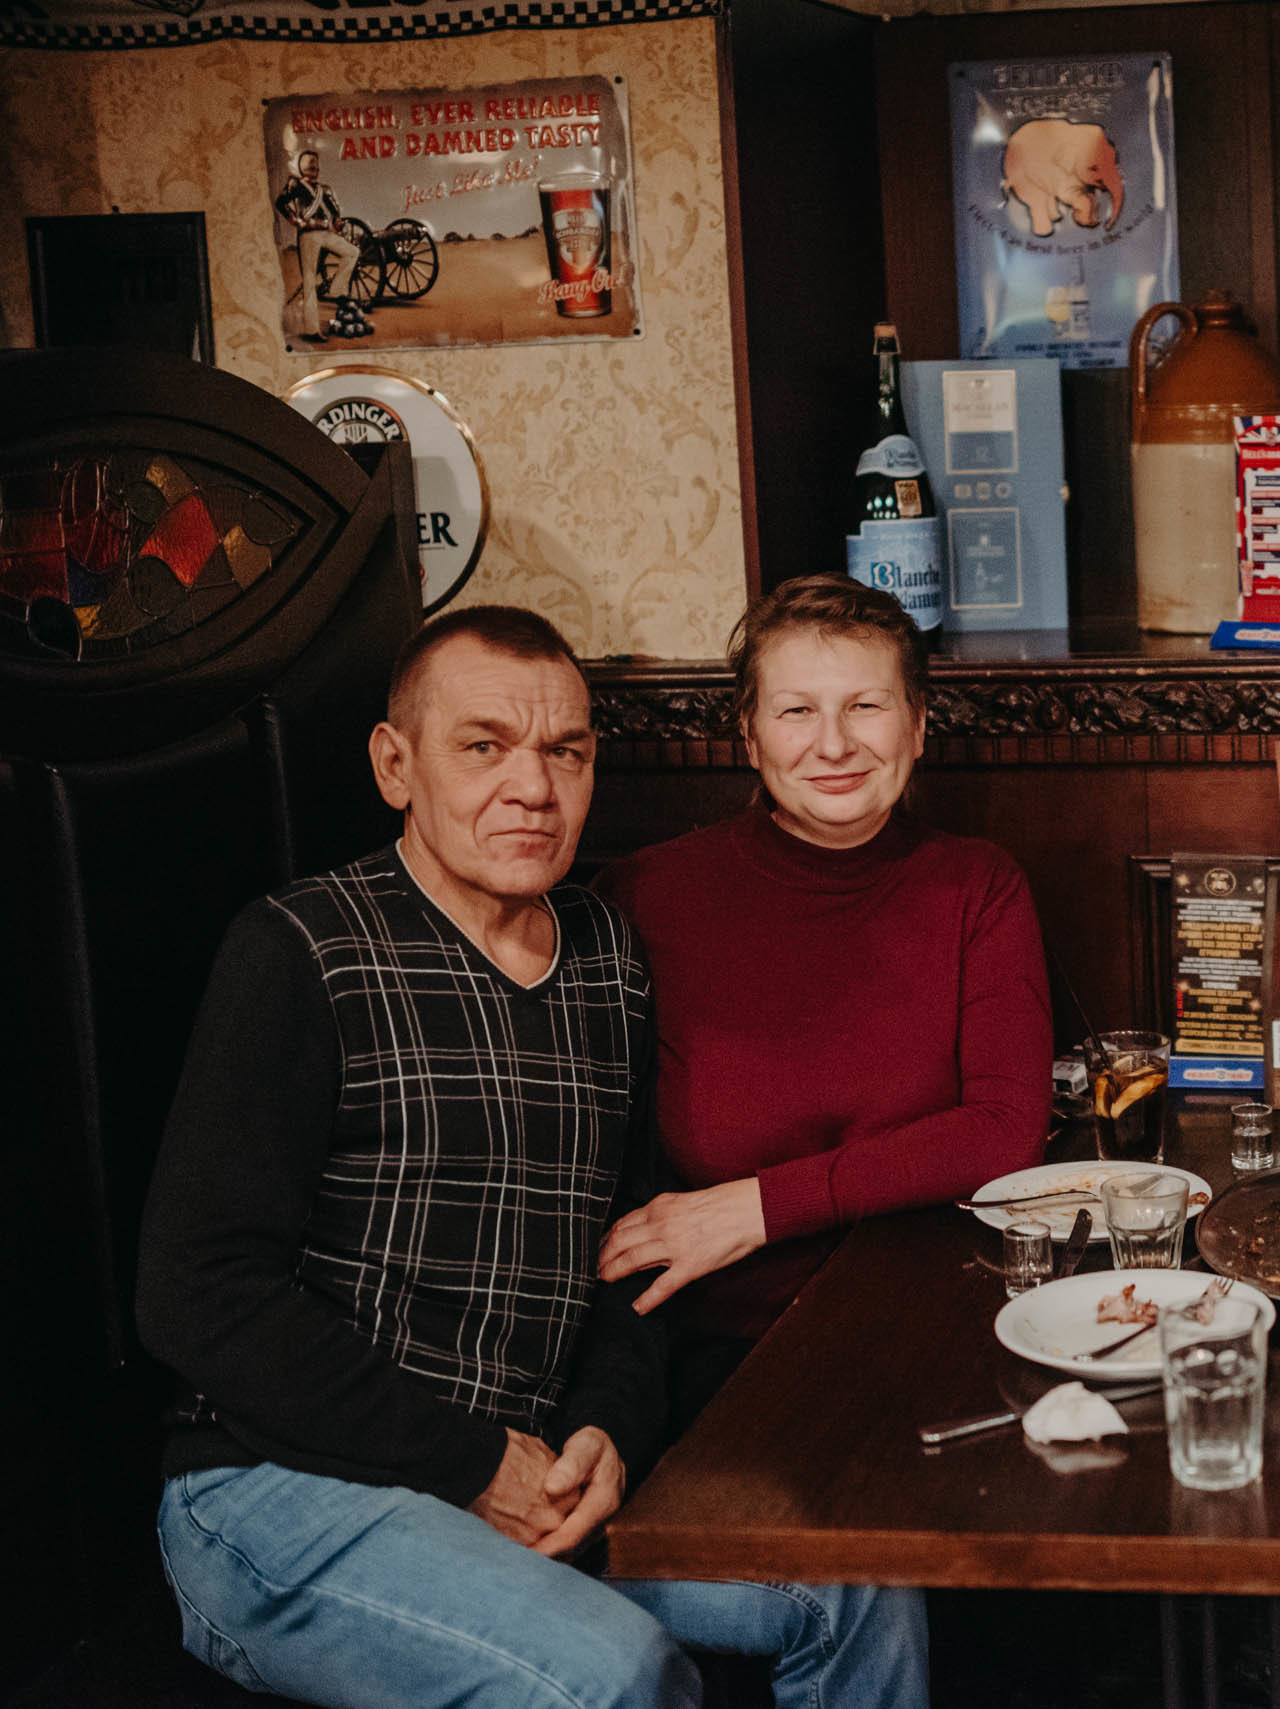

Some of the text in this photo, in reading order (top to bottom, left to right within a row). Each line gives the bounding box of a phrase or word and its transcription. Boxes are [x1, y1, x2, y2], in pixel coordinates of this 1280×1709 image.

[291, 92, 602, 134] ENGLISH, EVER RELIABLE
[340, 122, 602, 161] AND DAMNED TASTY
[402, 180, 451, 213] Just
[317, 403, 401, 440] RDINGER
